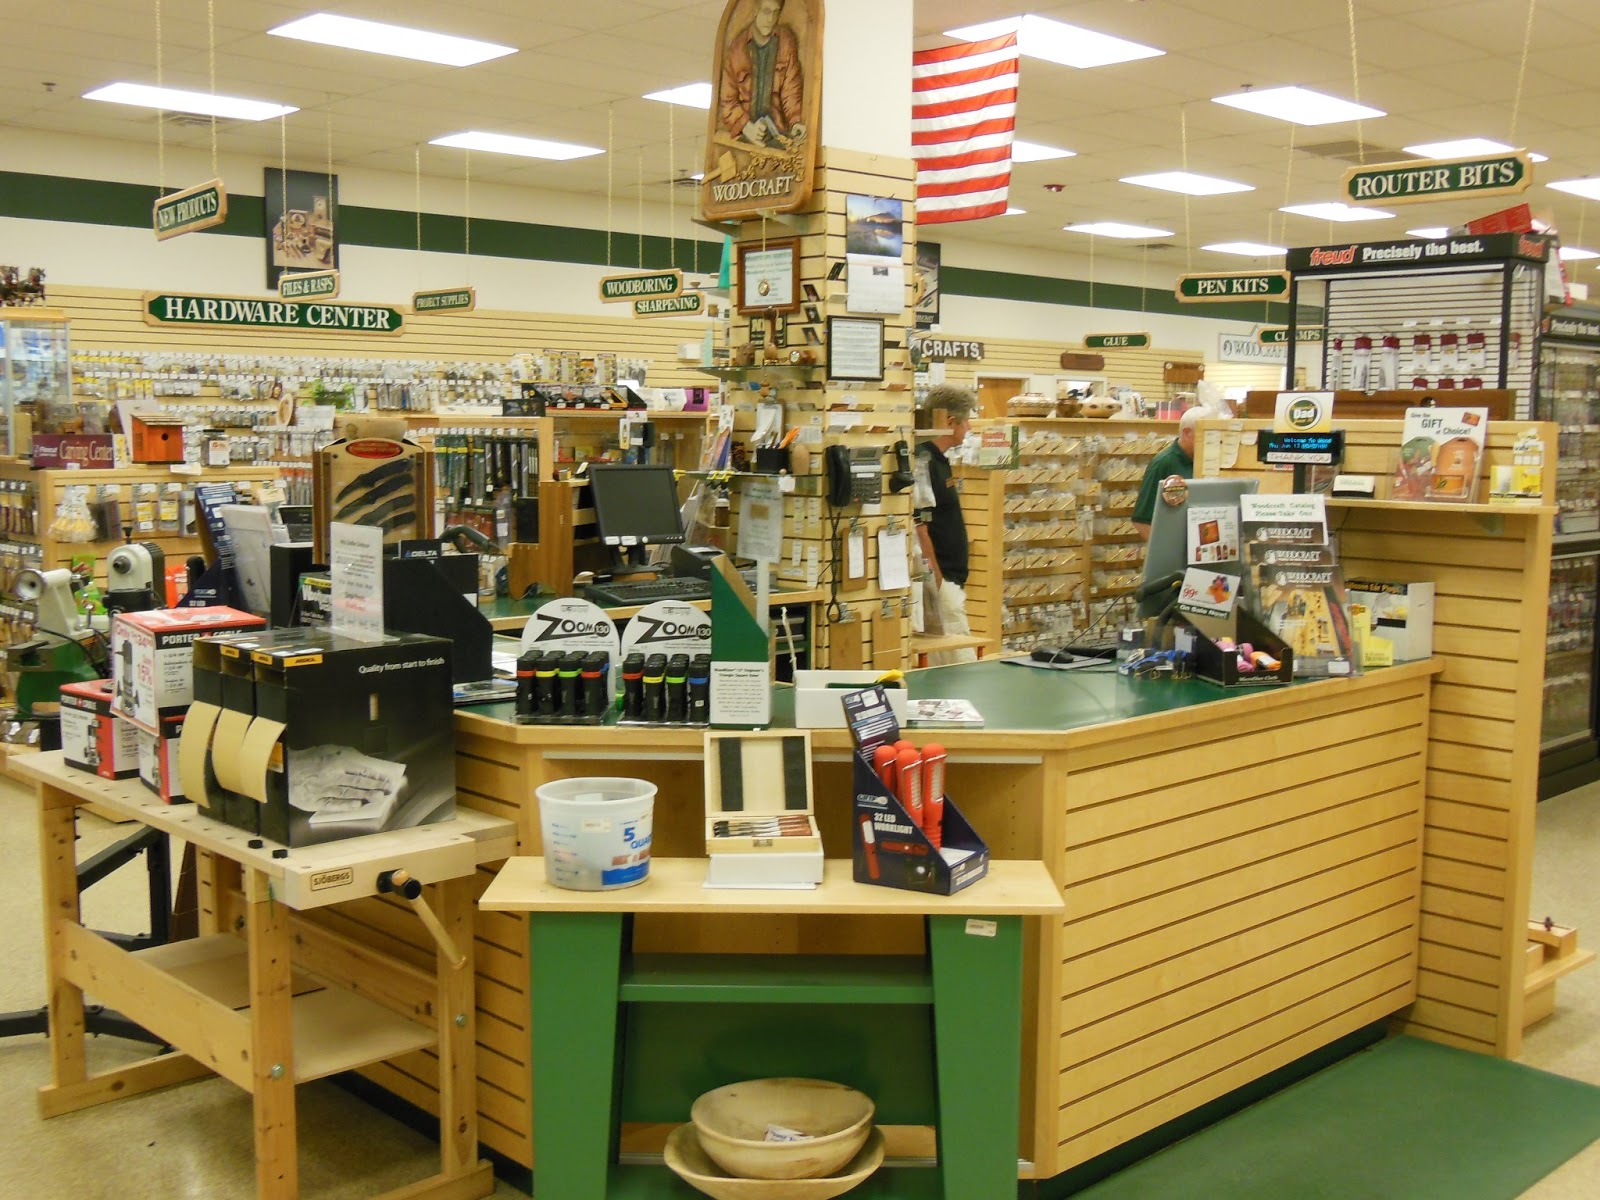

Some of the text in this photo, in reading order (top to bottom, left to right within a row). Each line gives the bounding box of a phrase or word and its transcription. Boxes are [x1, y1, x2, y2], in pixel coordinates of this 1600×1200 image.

[713, 175, 795, 202] WOODCRAFT
[1356, 161, 1515, 198] ROUTER BITS
[158, 191, 217, 229] NEW PRODUCTS
[1309, 244, 1357, 266] freud
[1362, 239, 1484, 262] Precisely the best.
[282, 276, 334, 296] FILES & RASPS
[606, 277, 674, 296] WOODBORING
[1197, 277, 1270, 295] PEN KITS
[416, 293, 469, 309] PROJECT SUPPLIES
[636, 296, 697, 314] SHARPENING
[165, 297, 391, 330] HARDWARE CENTER
[1103, 336, 1129, 347] GLUE
[1274, 330, 1321, 342] CLMPS
[922, 339, 980, 358] CRAFTS
[1233, 340, 1288, 358] WOODCRAF
[1293, 407, 1316, 419] Dad
[1421, 418, 1444, 429] GIFT
[1443, 427, 1472, 435] Choice!
[60, 440, 89, 467] Carving
[411, 549, 438, 557] DELTA
[1179, 604, 1191, 612] On
[534, 613, 596, 642] ZOOM
[634, 615, 696, 645] ZOOM
[162, 633, 201, 646] PORTER
[358, 657, 446, 675] Quality from start to finish
[873, 812, 897, 824] 32 LED
[623, 826, 636, 843] 5
[873, 822, 914, 835] WORKLIGHT
[313, 871, 351, 886] SJÖBERGS
